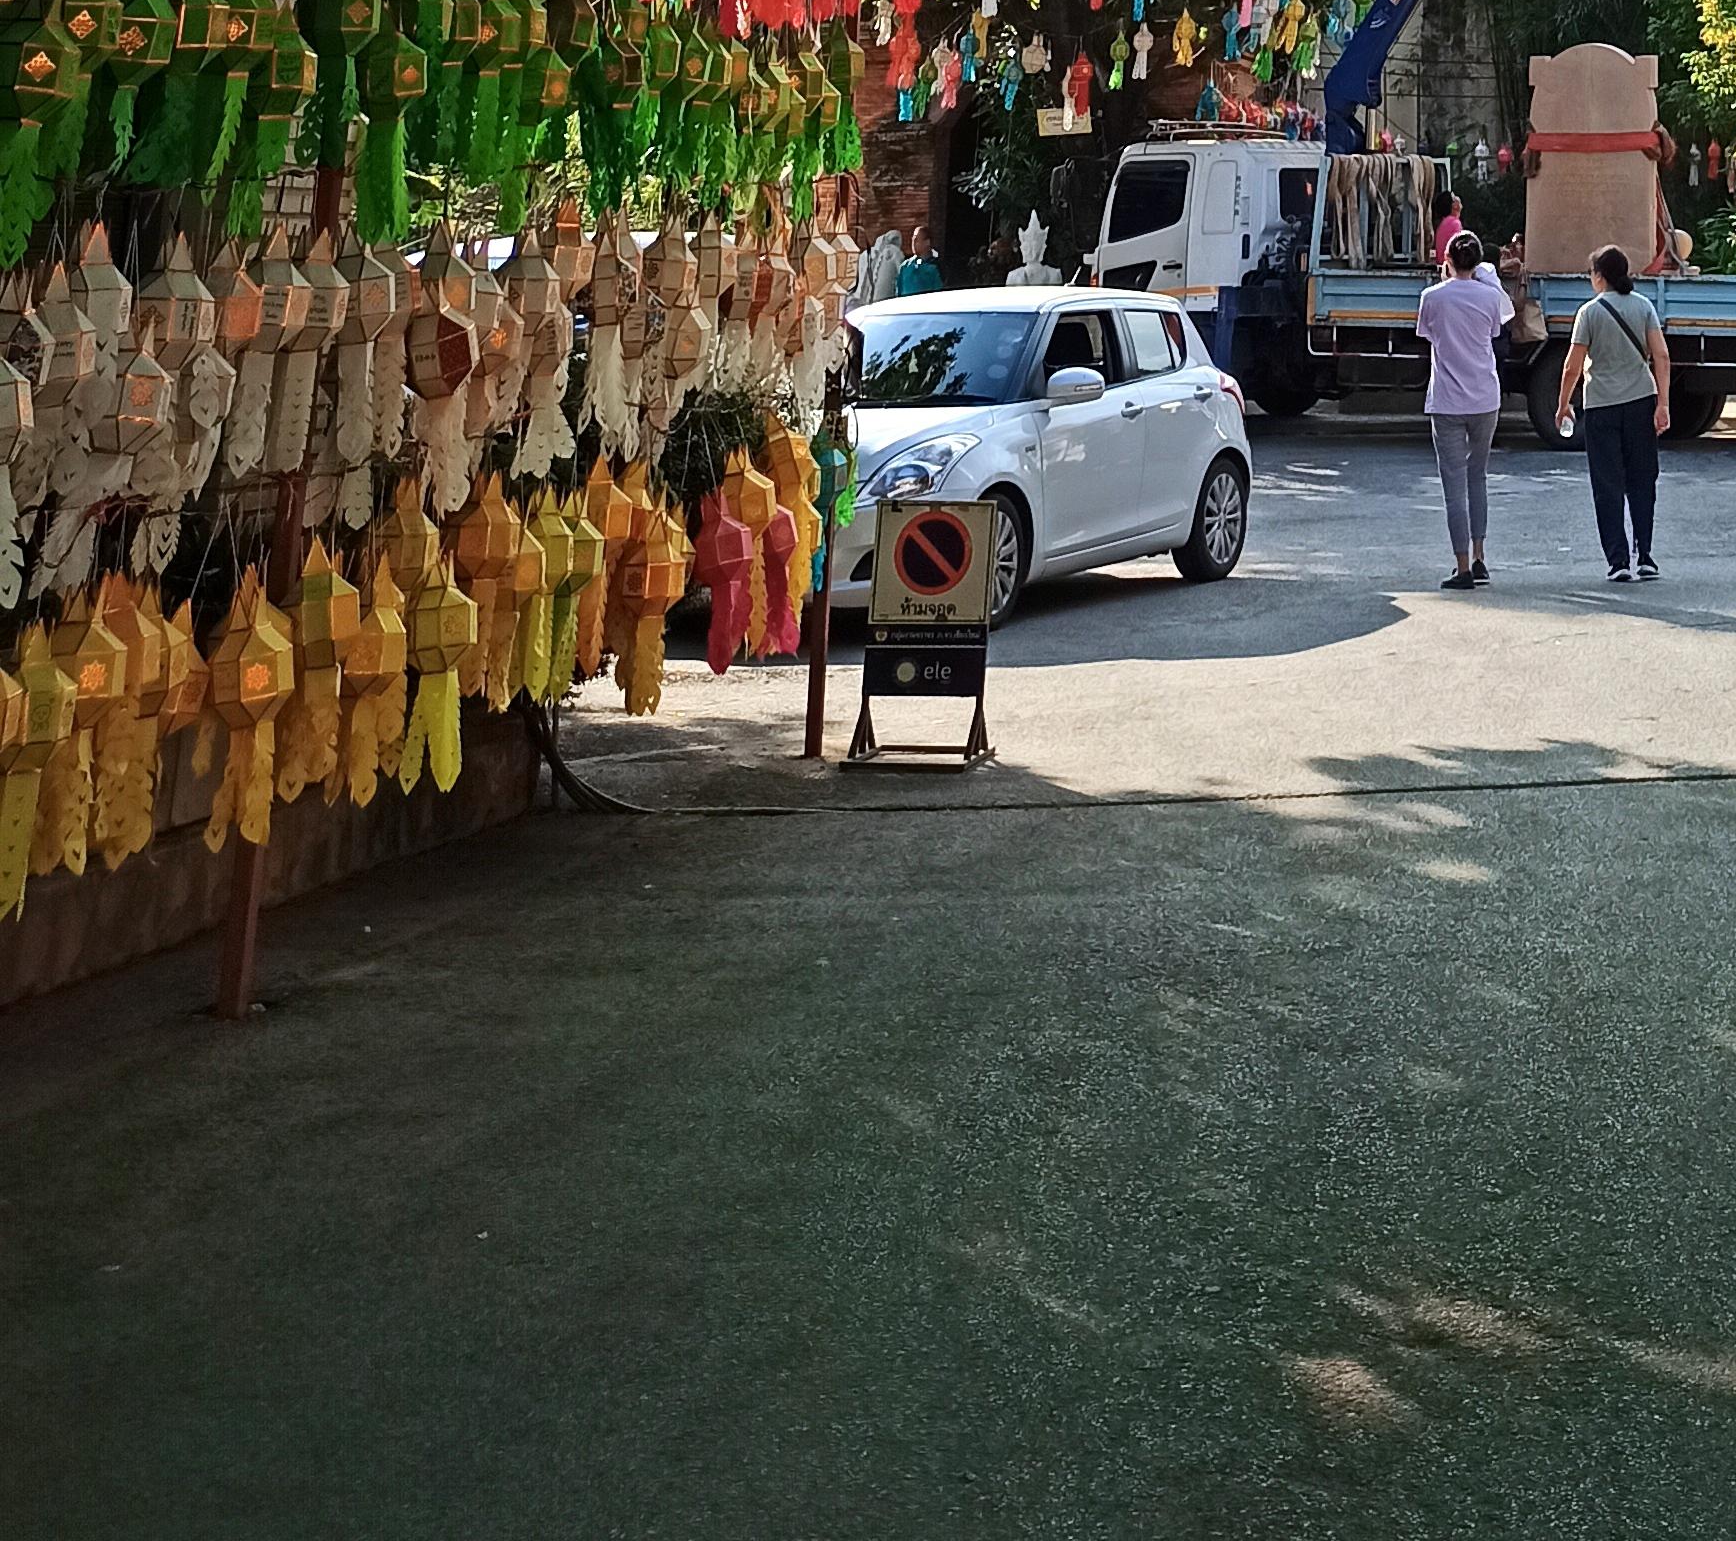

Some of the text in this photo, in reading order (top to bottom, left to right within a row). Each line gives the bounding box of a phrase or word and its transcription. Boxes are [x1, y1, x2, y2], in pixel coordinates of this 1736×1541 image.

[900, 596, 957, 616] ห้ามจอด
[924, 660, 951, 680] ele
